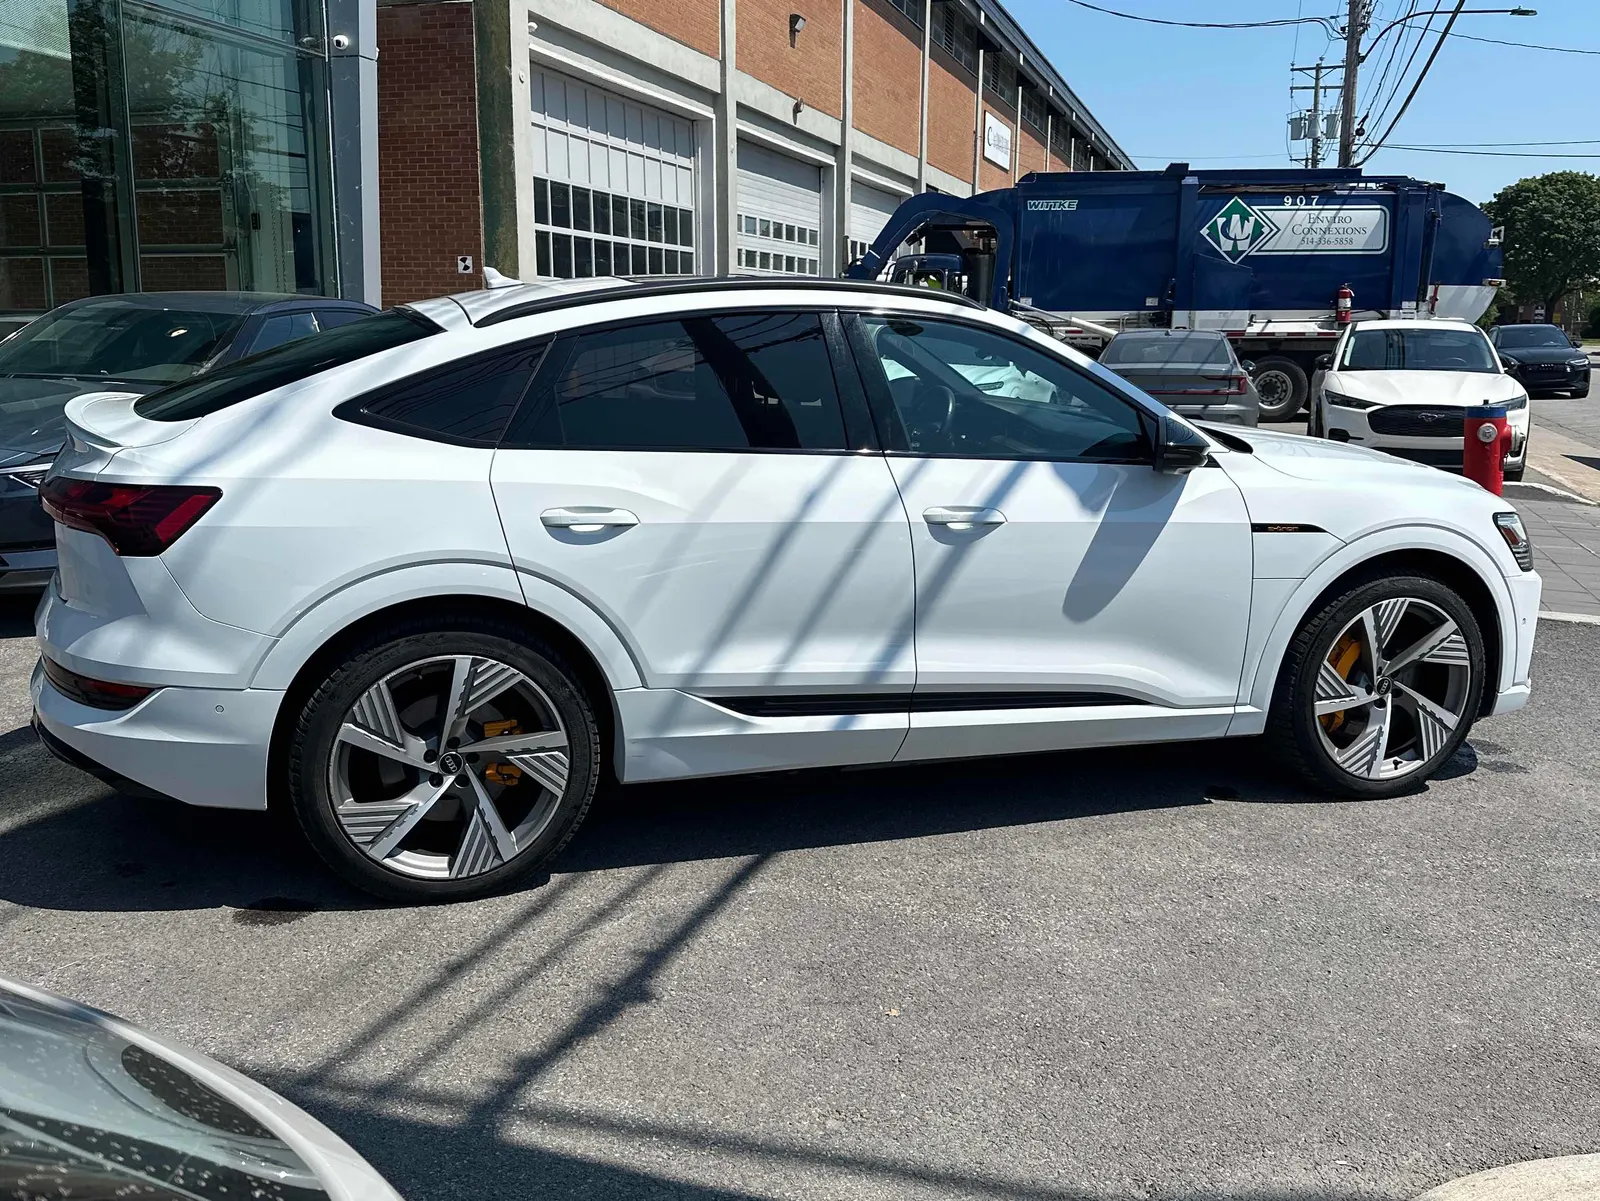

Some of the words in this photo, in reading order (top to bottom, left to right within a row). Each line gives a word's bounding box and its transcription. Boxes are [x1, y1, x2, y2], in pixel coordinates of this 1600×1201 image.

[1027, 199, 1079, 211] WITTKE
[1283, 195, 1320, 207] 907
[1307, 212, 1353, 225] ENVIRO
[1291, 223, 1368, 236] CONNEXIONS
[1300, 236, 1354, 246] 514-336-5858
